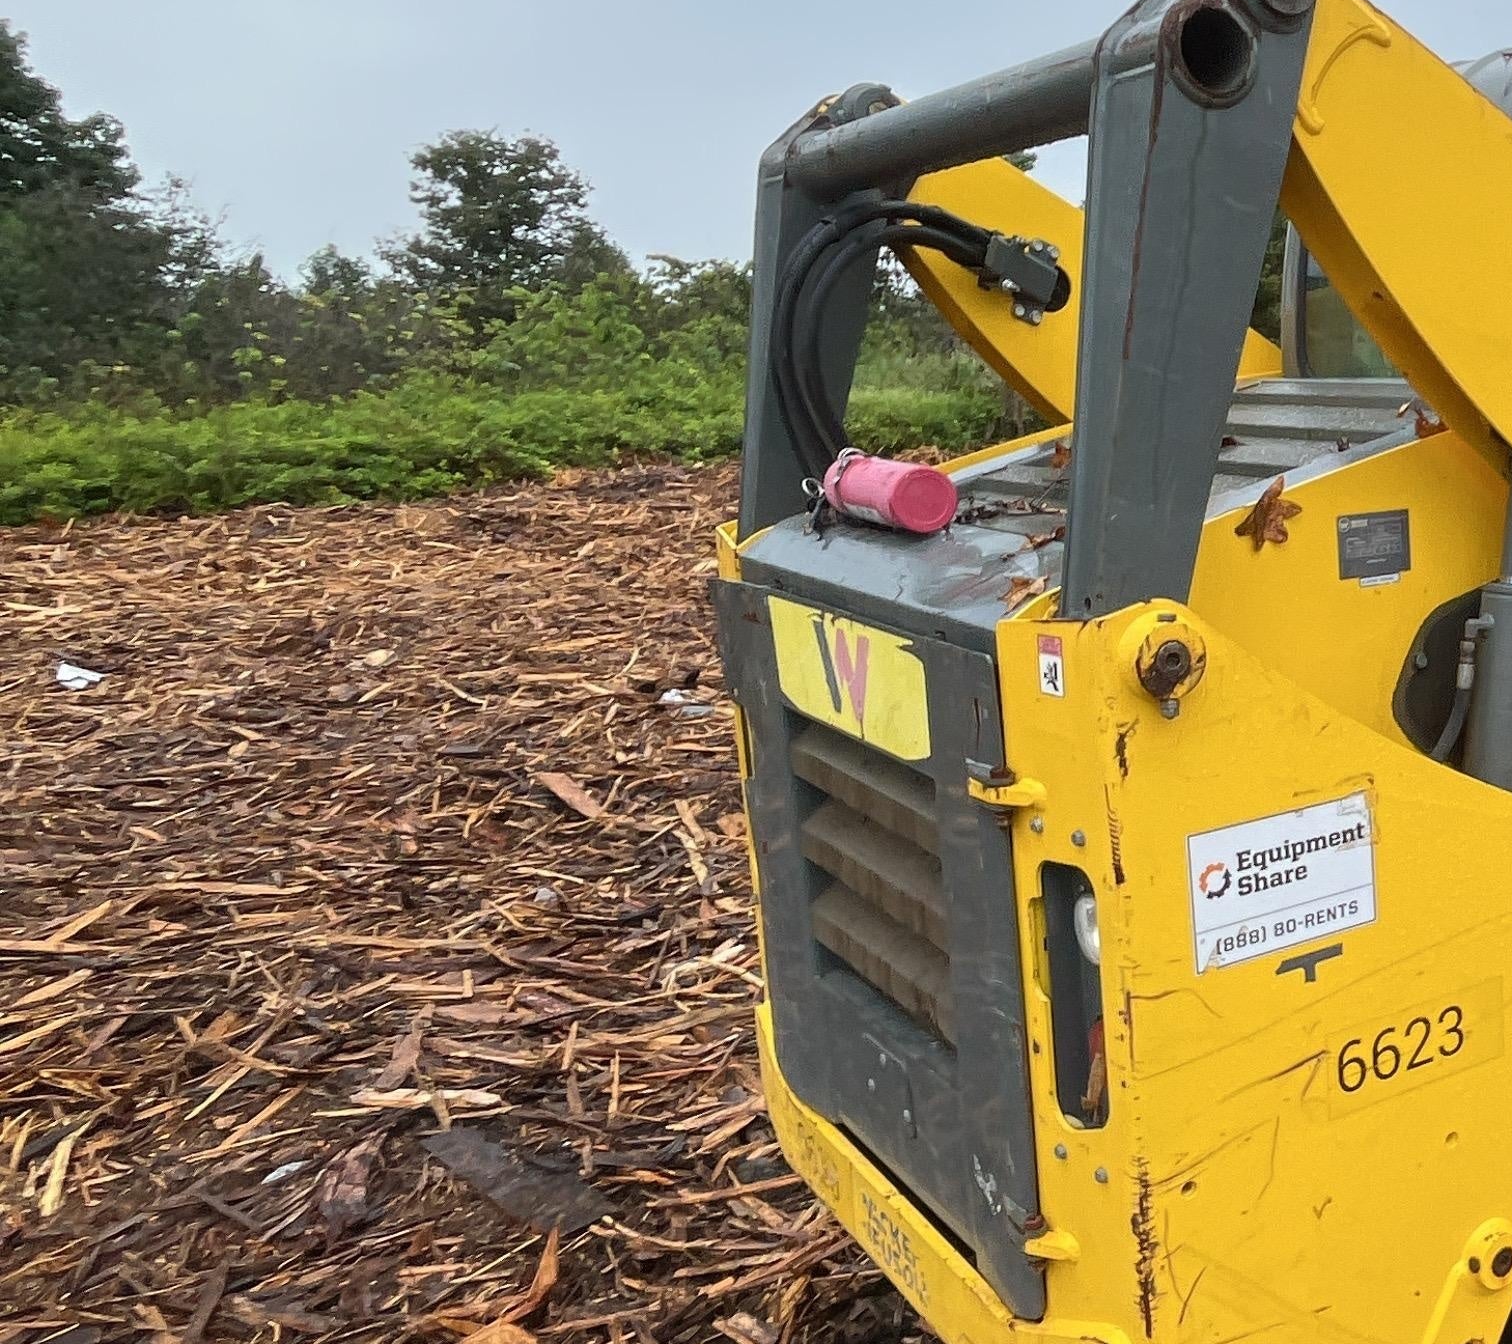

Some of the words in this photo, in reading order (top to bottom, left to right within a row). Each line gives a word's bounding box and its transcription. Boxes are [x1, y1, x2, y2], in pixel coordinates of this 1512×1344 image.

[1235, 821, 1366, 872] Equipment
[1237, 864, 1308, 896] Share
[1215, 926, 1267, 956] (888)
[1274, 900, 1359, 938] 80-RENTS
[1337, 1005, 1465, 1093] 6623
